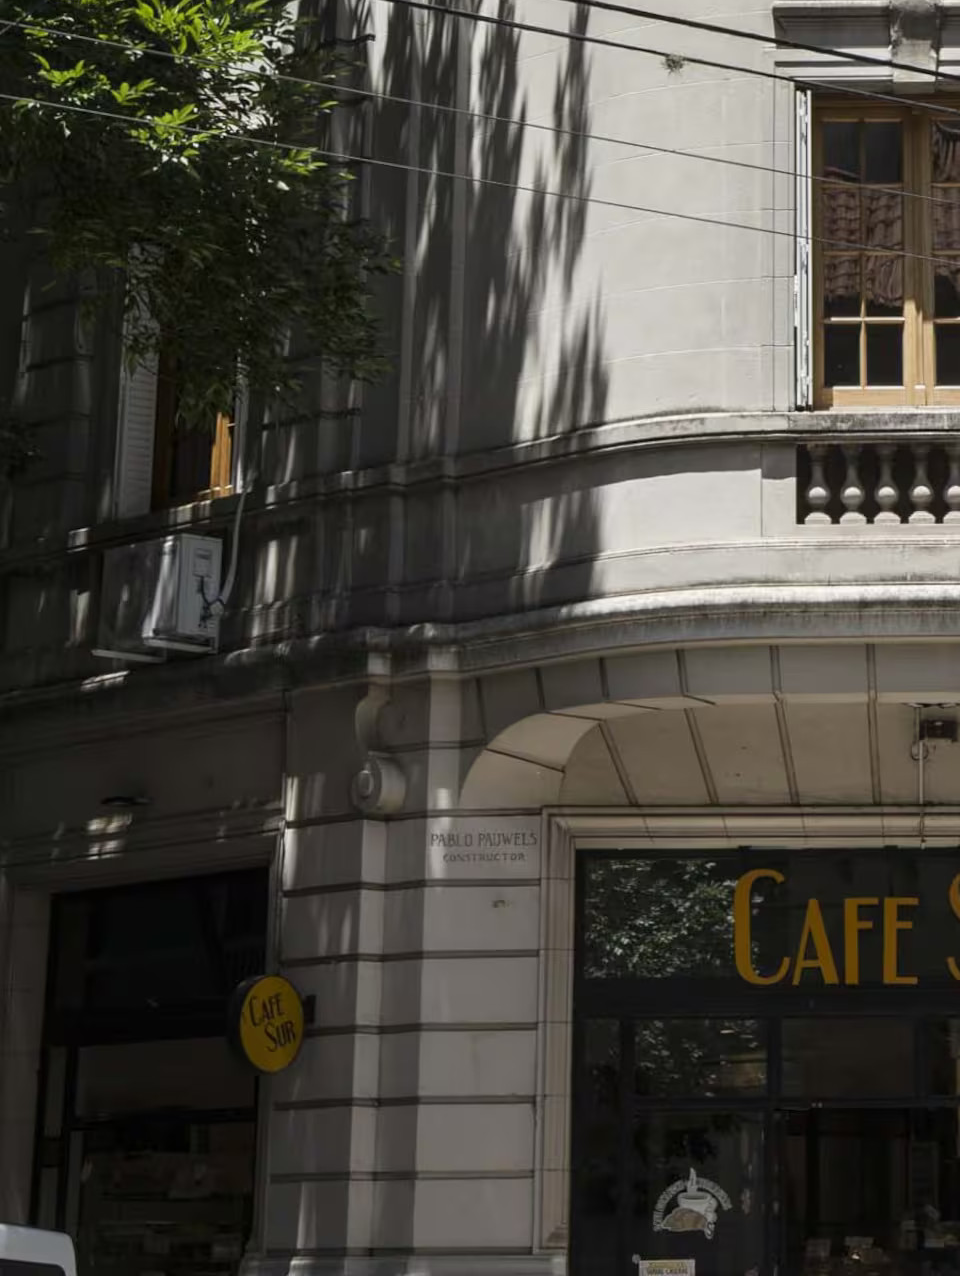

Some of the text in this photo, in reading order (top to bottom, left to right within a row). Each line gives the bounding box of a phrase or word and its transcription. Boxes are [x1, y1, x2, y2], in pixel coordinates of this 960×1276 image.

[430, 832, 538, 847] PABLO PAUWELS
[443, 852, 526, 862] CONSTRUCTOR
[733, 868, 919, 986] CAFE
[249, 992, 285, 1028] CAFE
[264, 1020, 296, 1052] SUR
